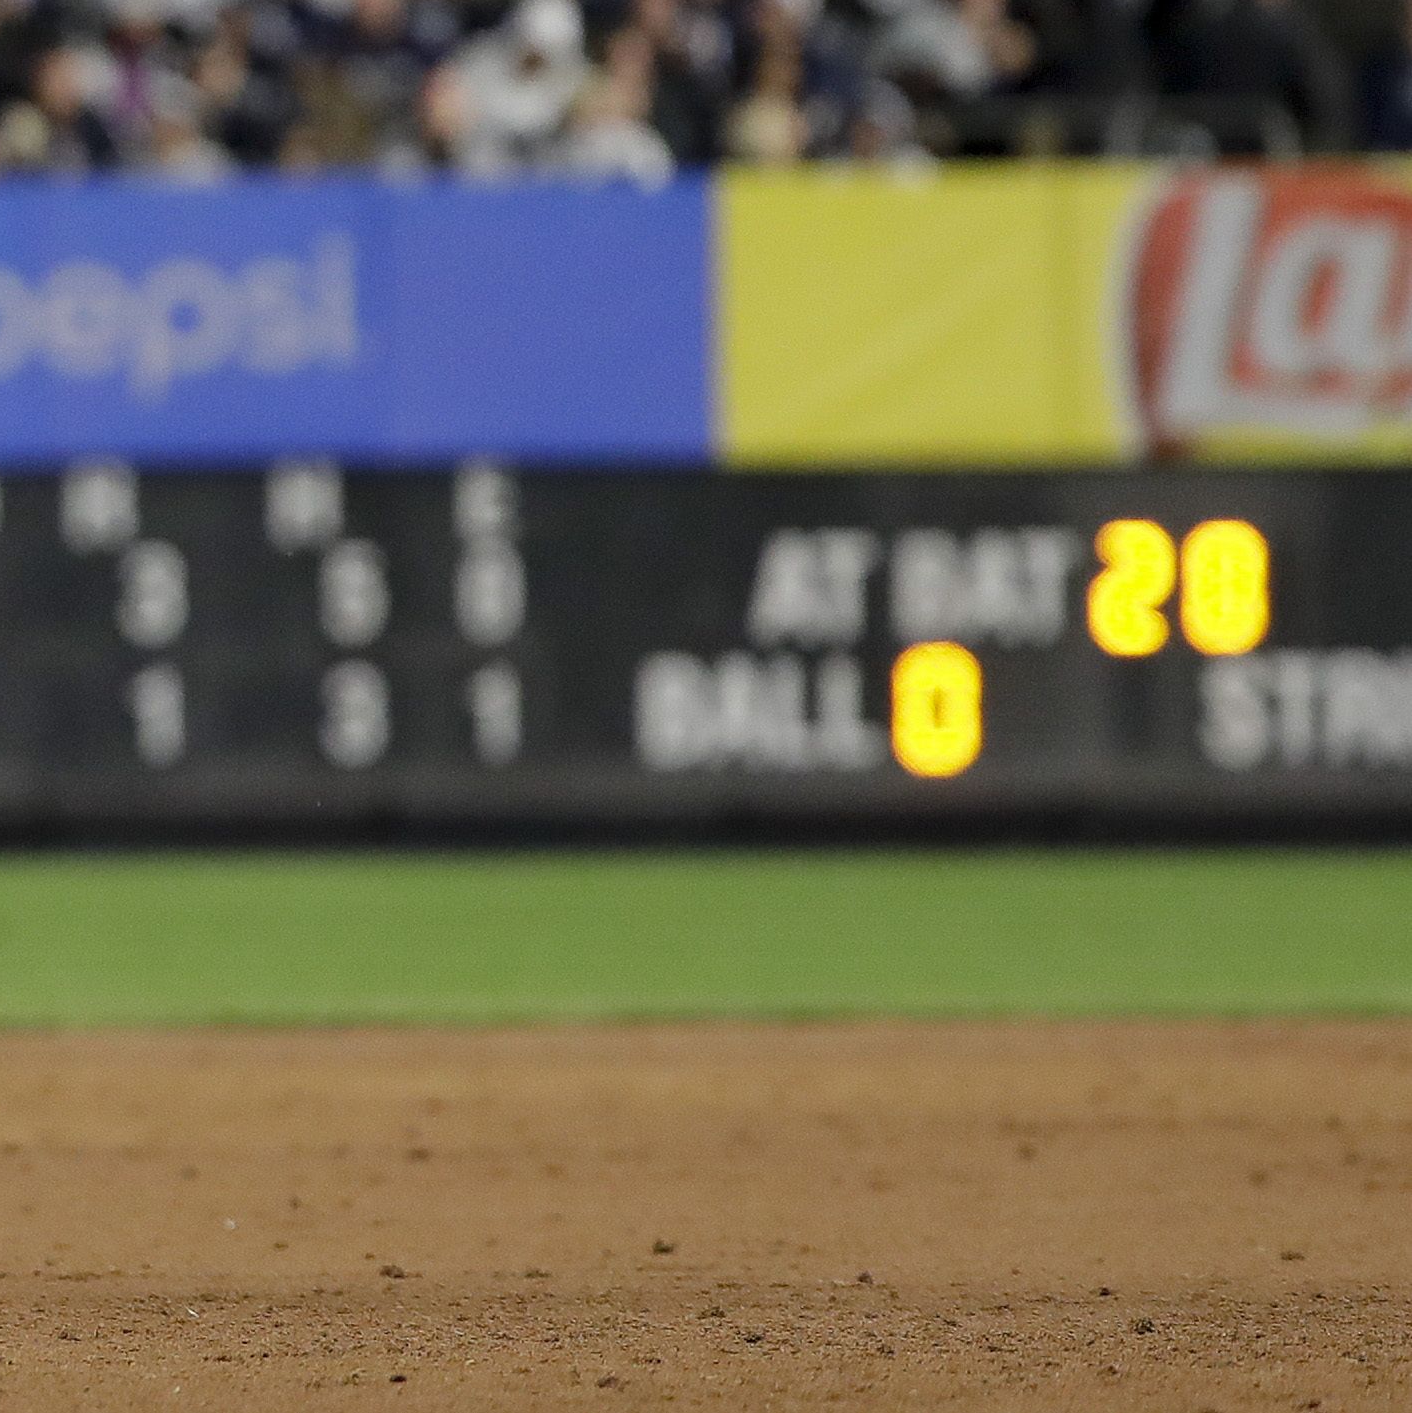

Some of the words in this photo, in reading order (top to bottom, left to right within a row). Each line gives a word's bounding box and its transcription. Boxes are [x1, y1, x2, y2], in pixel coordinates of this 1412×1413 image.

[116, 538, 189, 649] 3
[748, 526, 879, 642] AT
[888, 526, 1075, 644] BAT
[125, 659, 186, 771] 1
[463, 659, 523, 771] 1
[633, 651, 883, 772] BALL
[889, 641, 983, 777] 0
